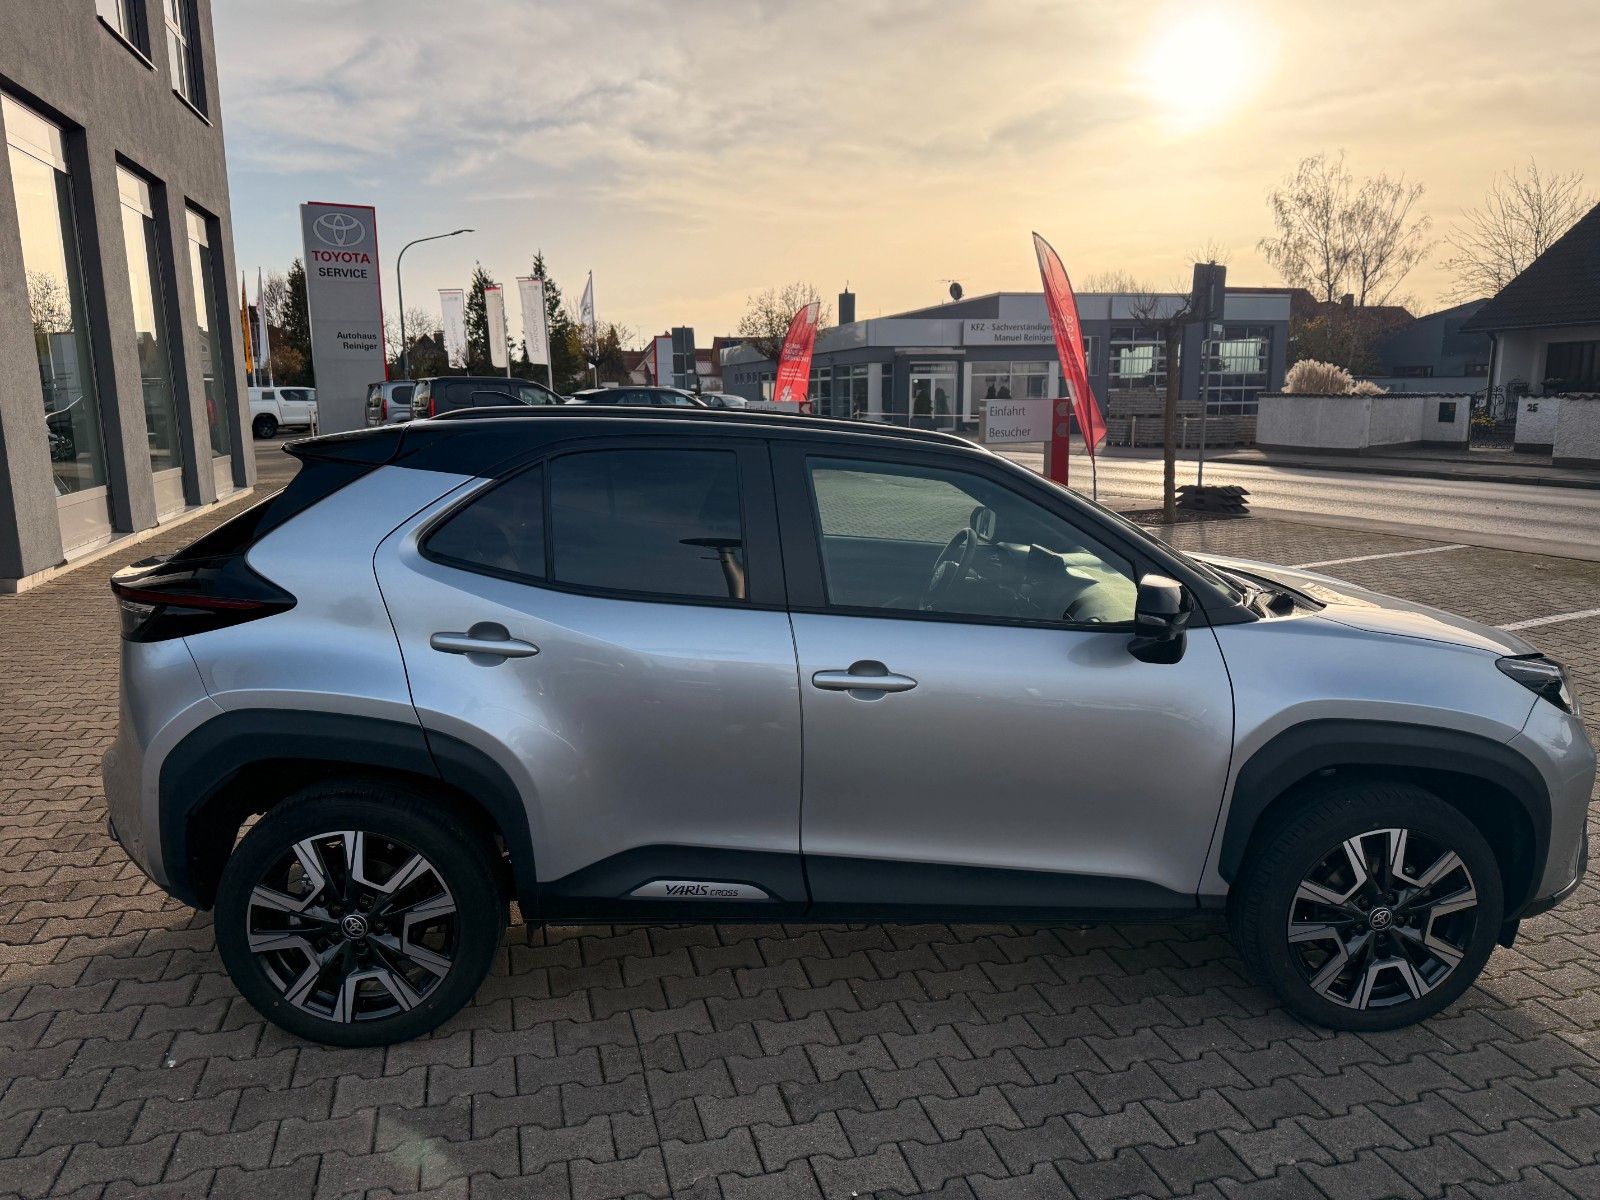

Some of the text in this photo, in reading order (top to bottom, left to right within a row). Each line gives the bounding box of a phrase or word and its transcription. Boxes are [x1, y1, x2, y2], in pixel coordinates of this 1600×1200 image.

[312, 250, 371, 264] TOYOTA
[318, 267, 368, 279] SERVICE
[971, 323, 985, 331] KFZ
[337, 331, 377, 340] Autohaus
[995, 333, 1053, 343] Manuel Reiniger
[343, 341, 378, 351] Reiniger
[989, 405, 1026, 417] Einfahrt
[989, 426, 1031, 438] Besucher
[665, 884, 739, 897] YARIS CROSS
